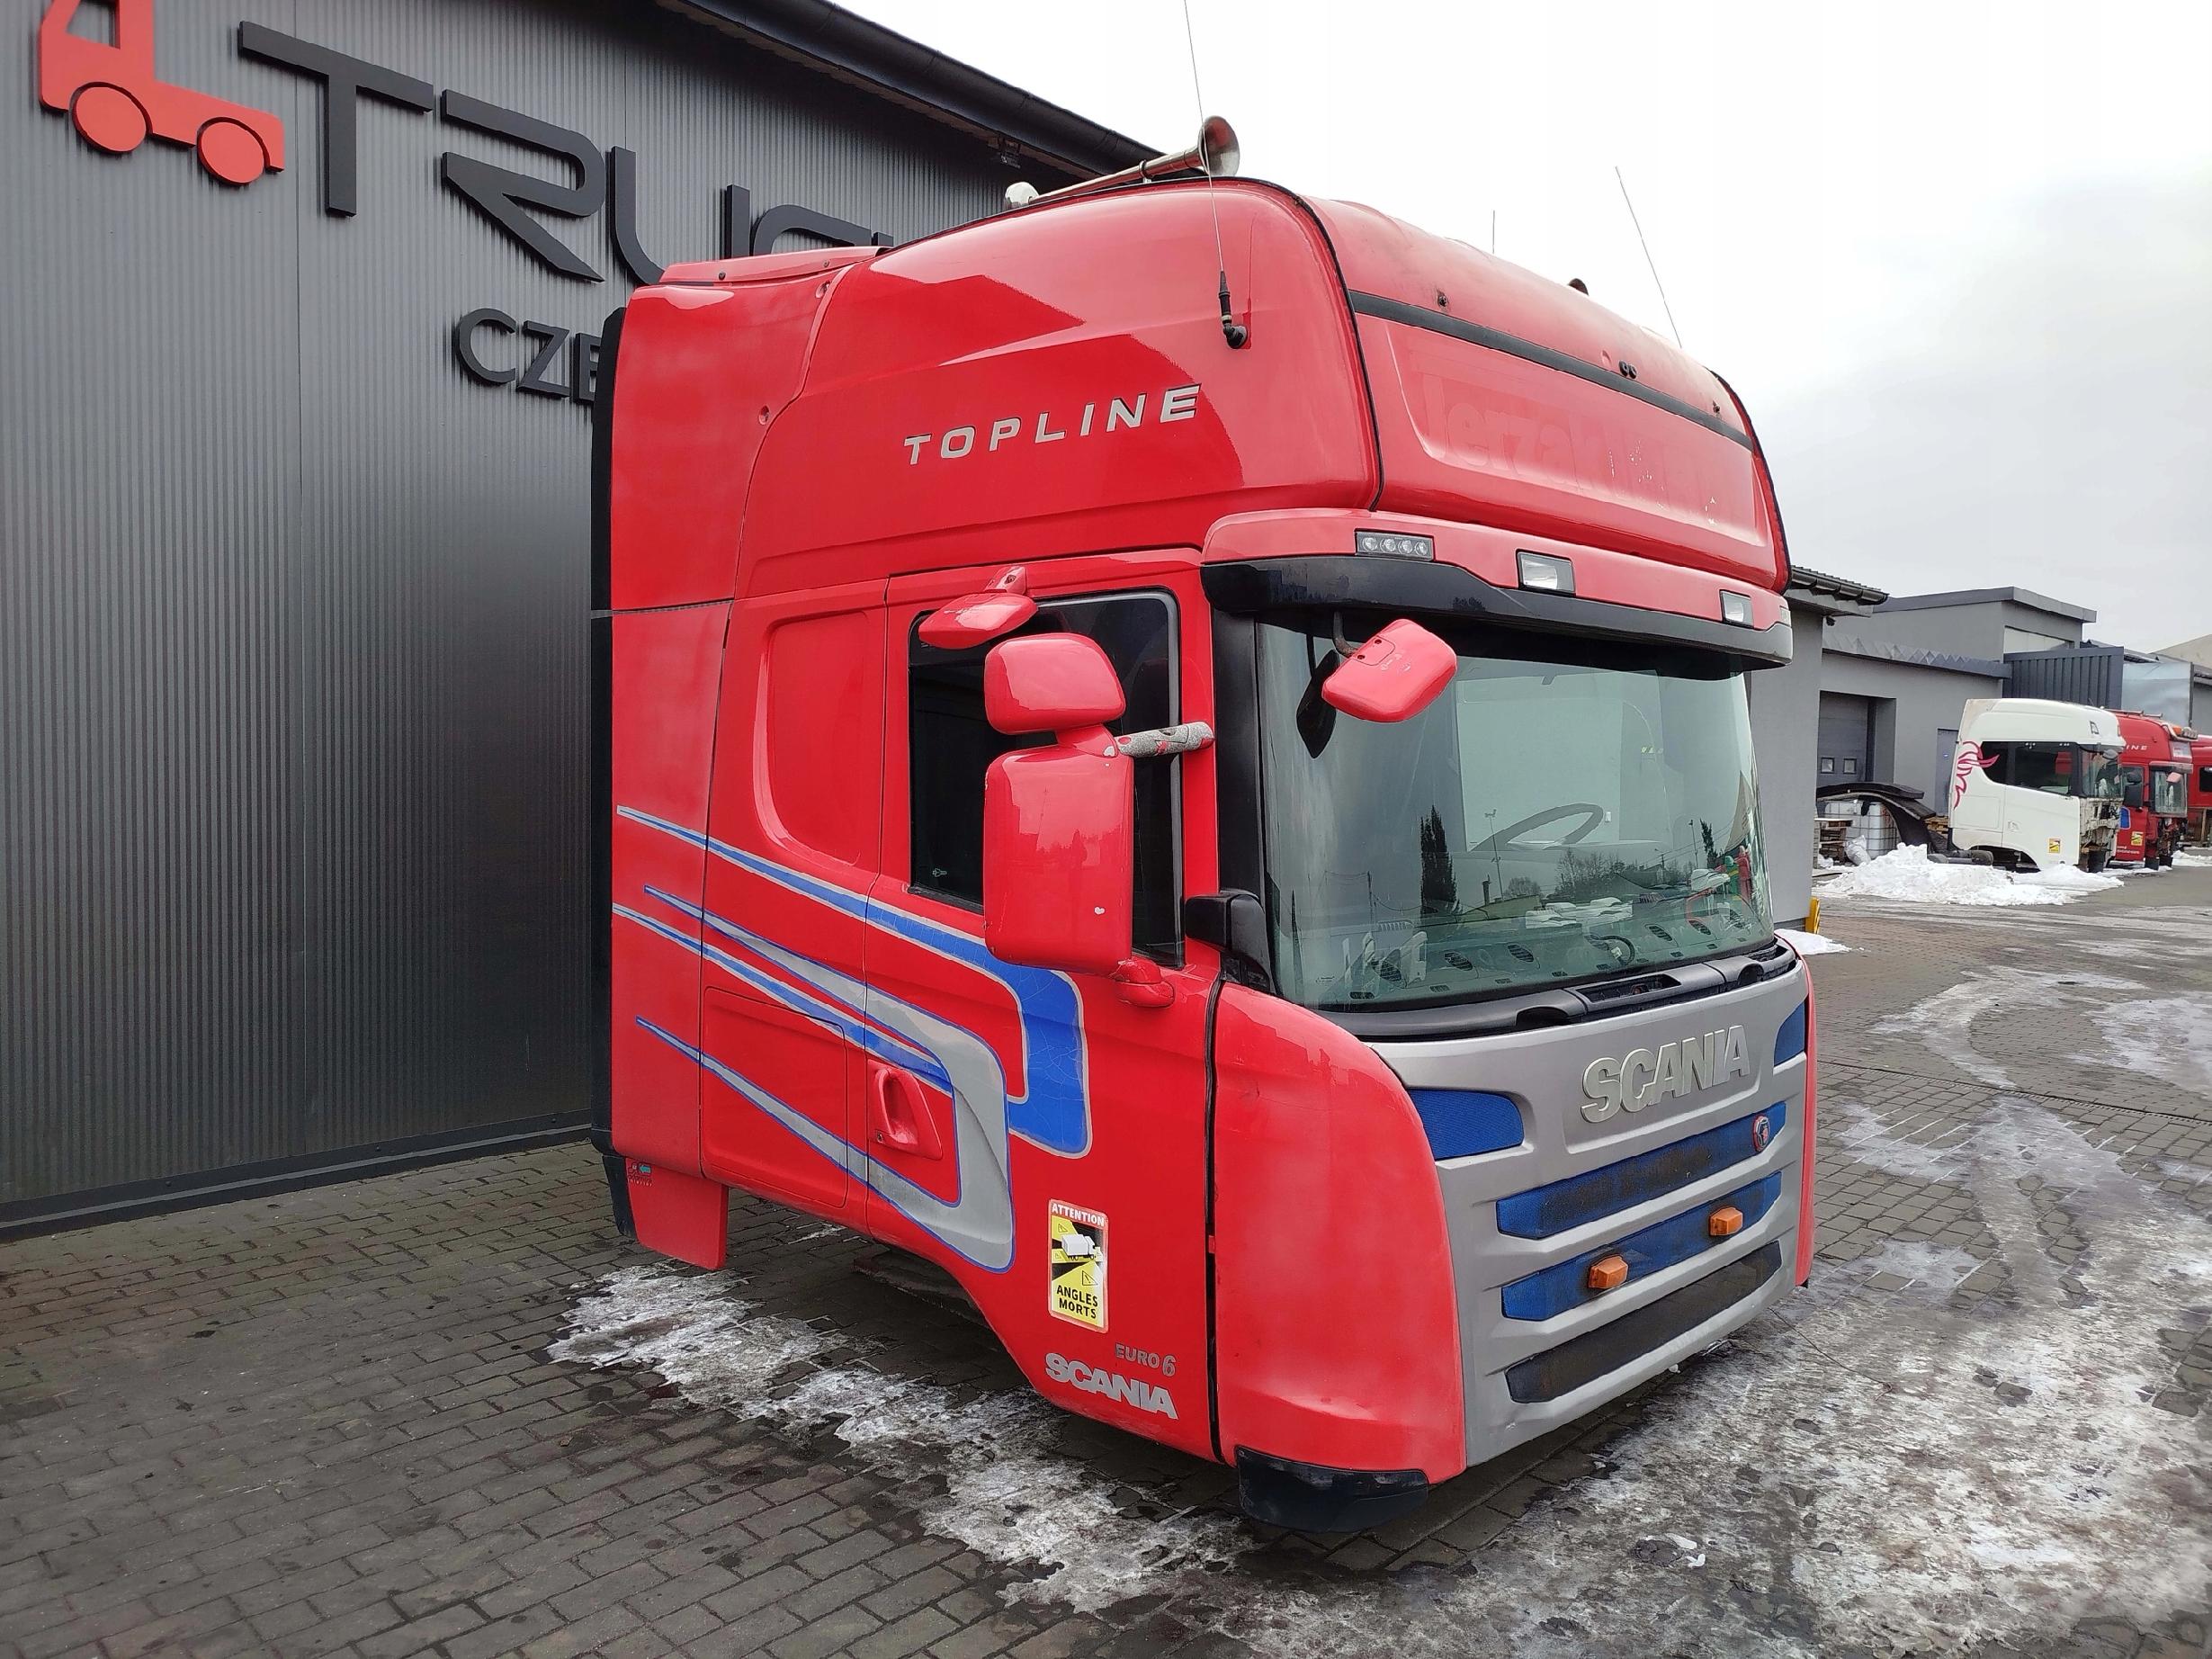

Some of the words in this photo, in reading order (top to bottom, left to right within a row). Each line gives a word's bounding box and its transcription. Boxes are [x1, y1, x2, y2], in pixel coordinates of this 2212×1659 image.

[237, 20, 894, 285] TRU
[903, 382, 1202, 465] TOPLINE
[1580, 1025, 1750, 1124] SCANIA
[1052, 1203, 1105, 1227] ATTENTION
[1056, 1285, 1098, 1308] ANGLES
[1059, 1297, 1097, 1320] MORTS
[1044, 1352, 1179, 1420] SCANIA
